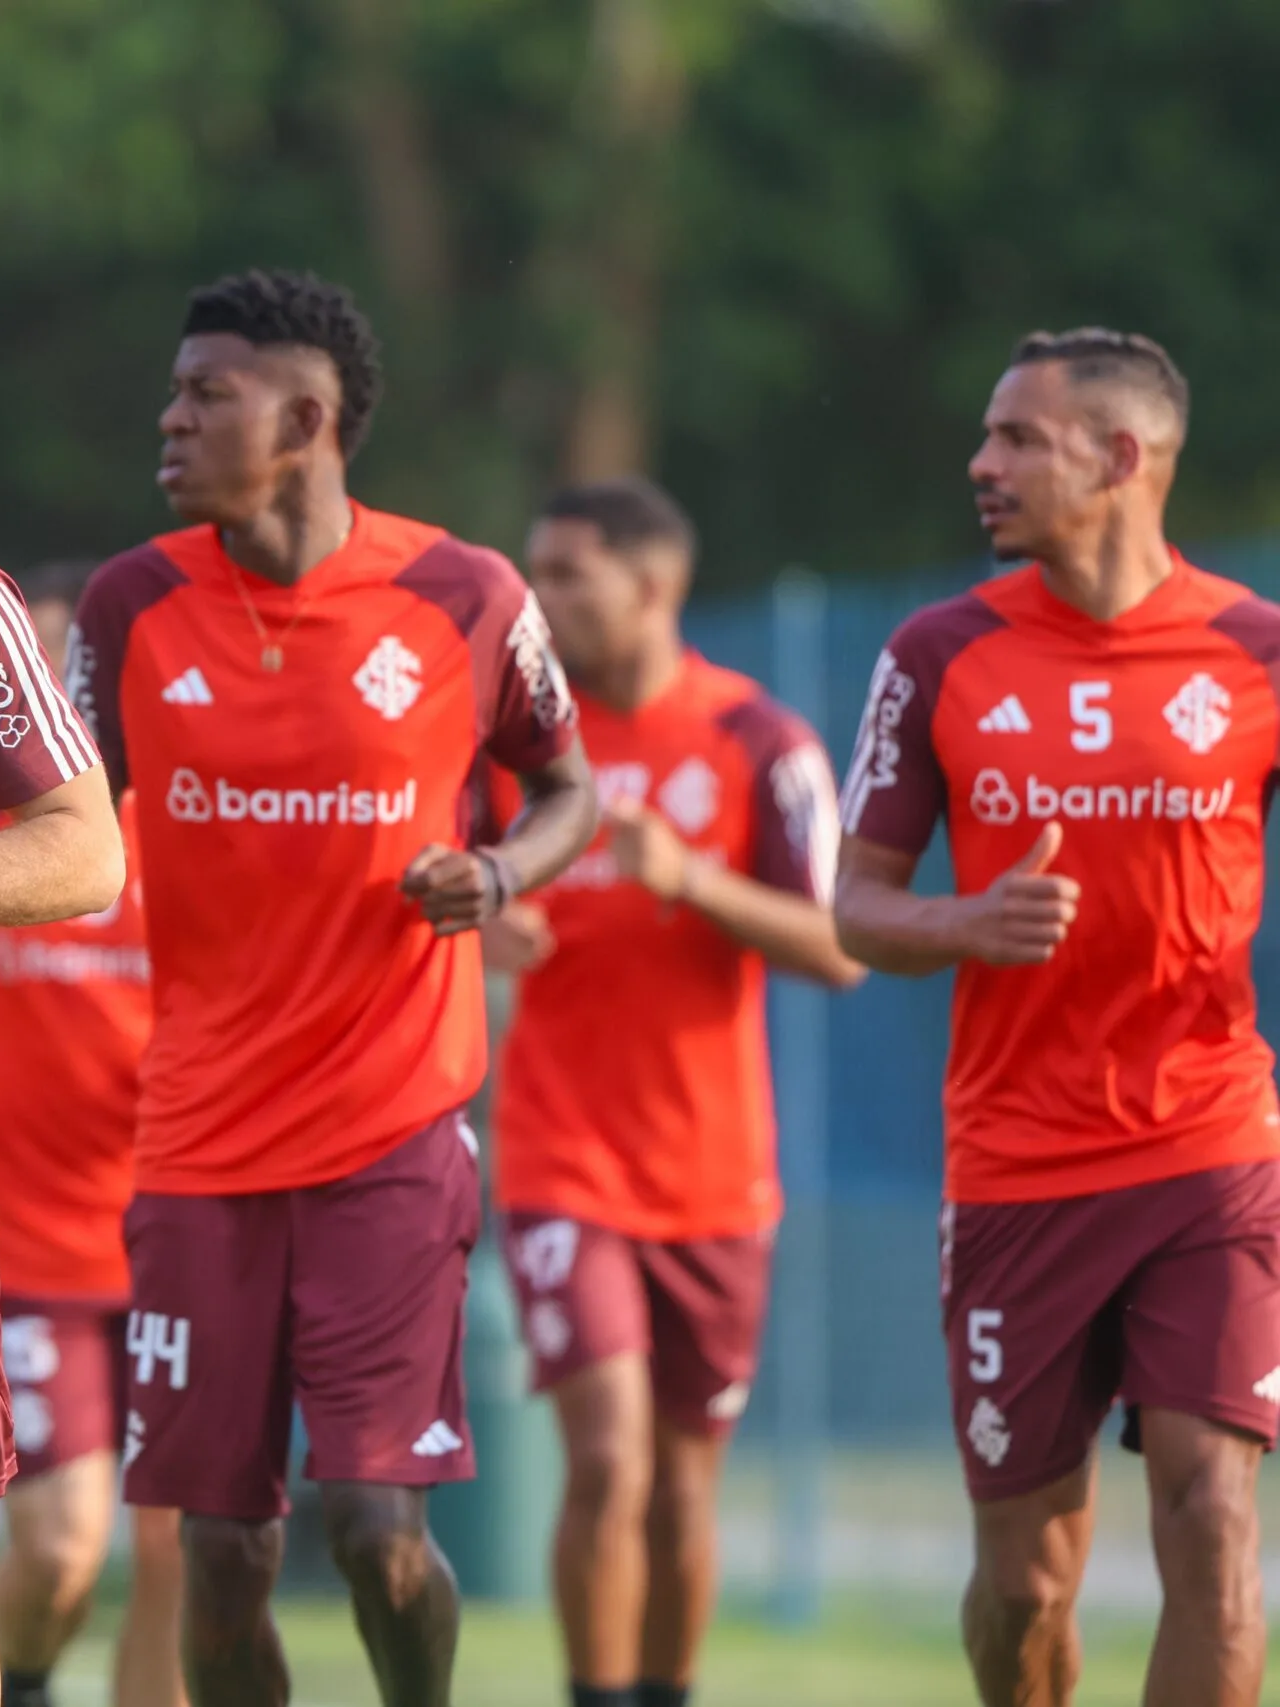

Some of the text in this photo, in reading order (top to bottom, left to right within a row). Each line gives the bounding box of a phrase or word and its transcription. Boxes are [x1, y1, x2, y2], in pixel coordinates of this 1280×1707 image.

[1069, 680, 1113, 752] 5
[216, 778, 418, 825] banrisul
[1026, 774, 1235, 823] banrisul
[126, 1310, 191, 1390] 44
[968, 1309, 1004, 1382] 5
